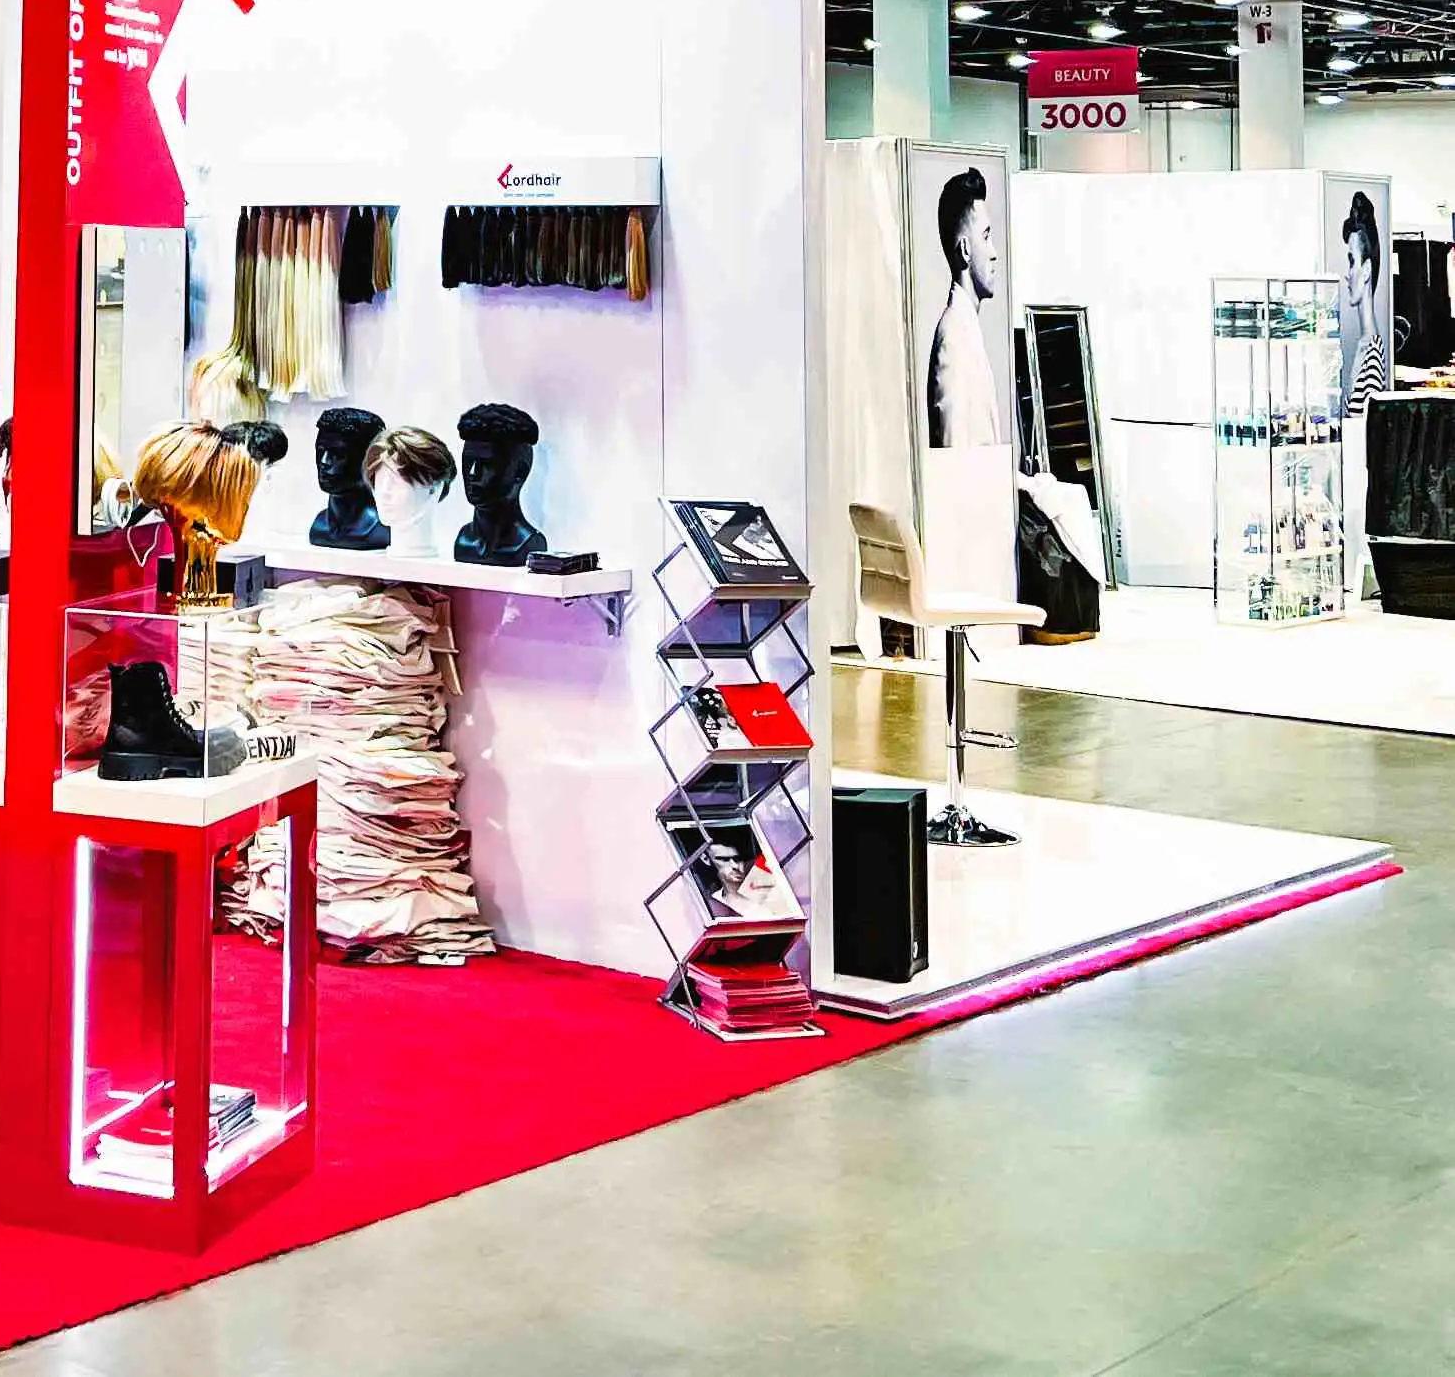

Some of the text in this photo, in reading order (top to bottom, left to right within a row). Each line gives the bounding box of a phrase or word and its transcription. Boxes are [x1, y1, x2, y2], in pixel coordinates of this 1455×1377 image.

[1249, 5, 1273, 18] W-3
[1054, 68, 1111, 83] BEAUTY
[66, 51, 85, 186] OUTFIT
[1040, 101, 1127, 130] 3000
[506, 173, 562, 187] Lordhair
